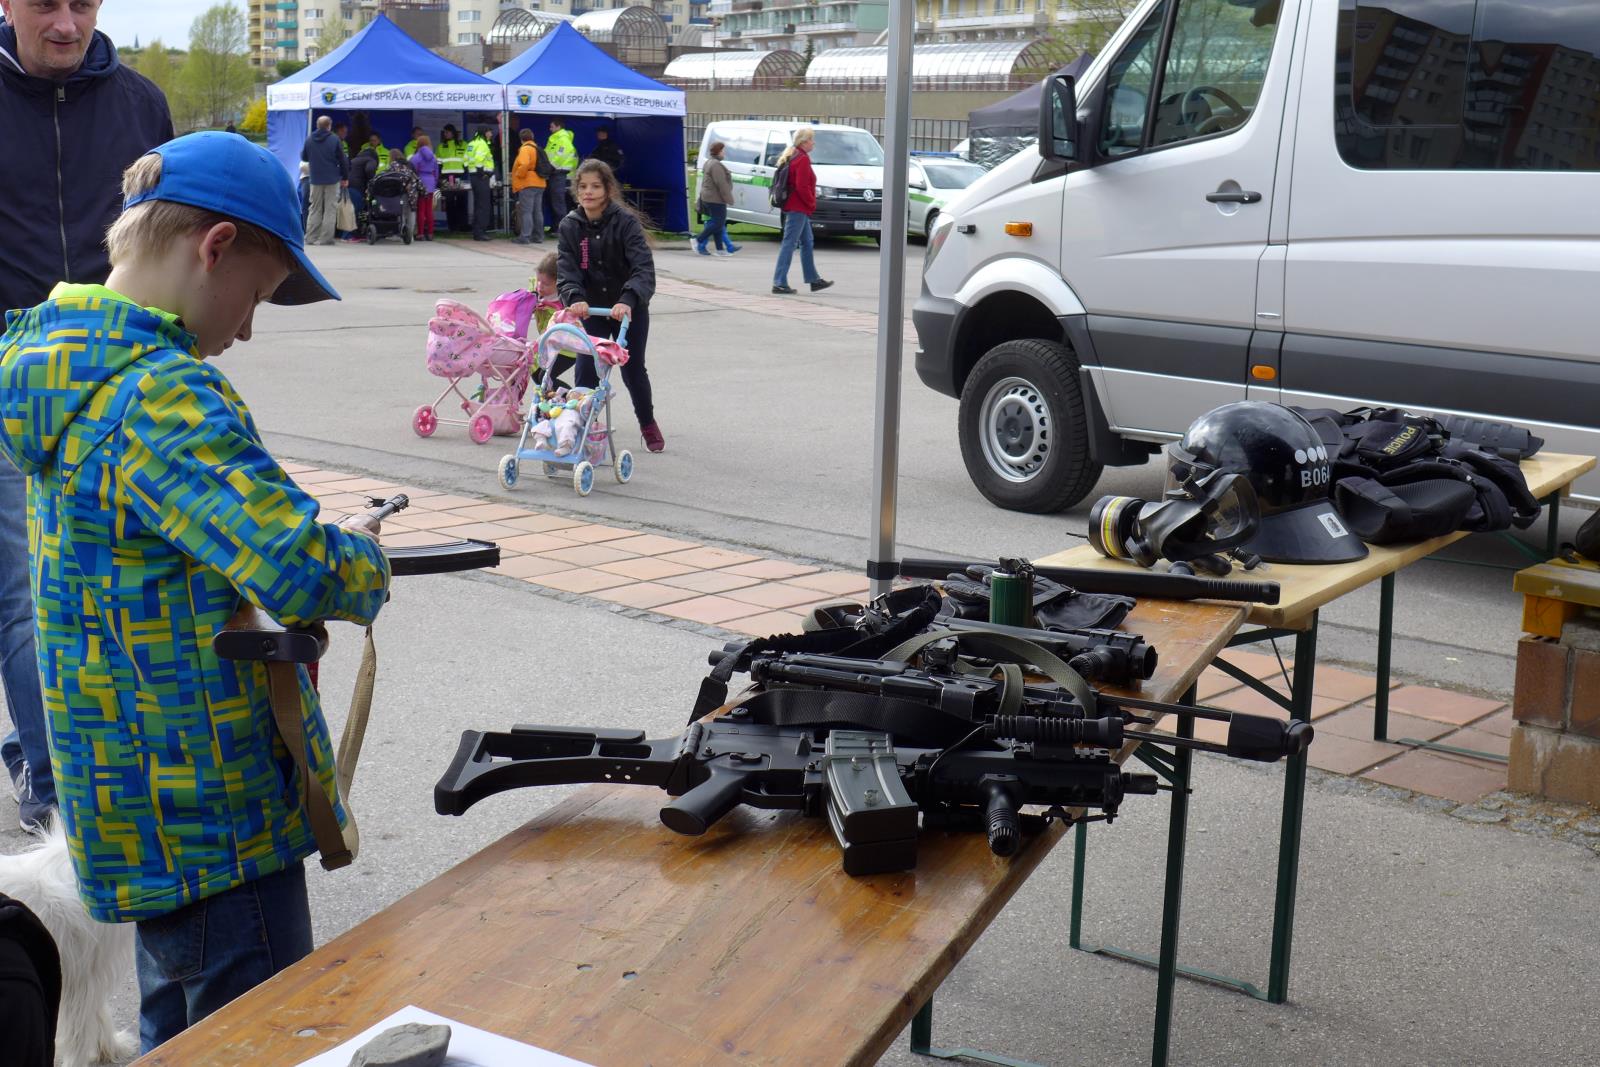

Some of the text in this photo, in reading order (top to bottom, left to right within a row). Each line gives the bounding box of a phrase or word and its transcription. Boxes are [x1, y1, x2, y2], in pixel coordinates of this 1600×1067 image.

[343, 89, 495, 103] CELNÍ SPRÁVA ČESKÉ REPUBLIKY
[537, 93, 678, 108] CELNÍ SPRÁVA ČESKÉ REPUBLIKY
[1383, 426, 1416, 455] POLICIE
